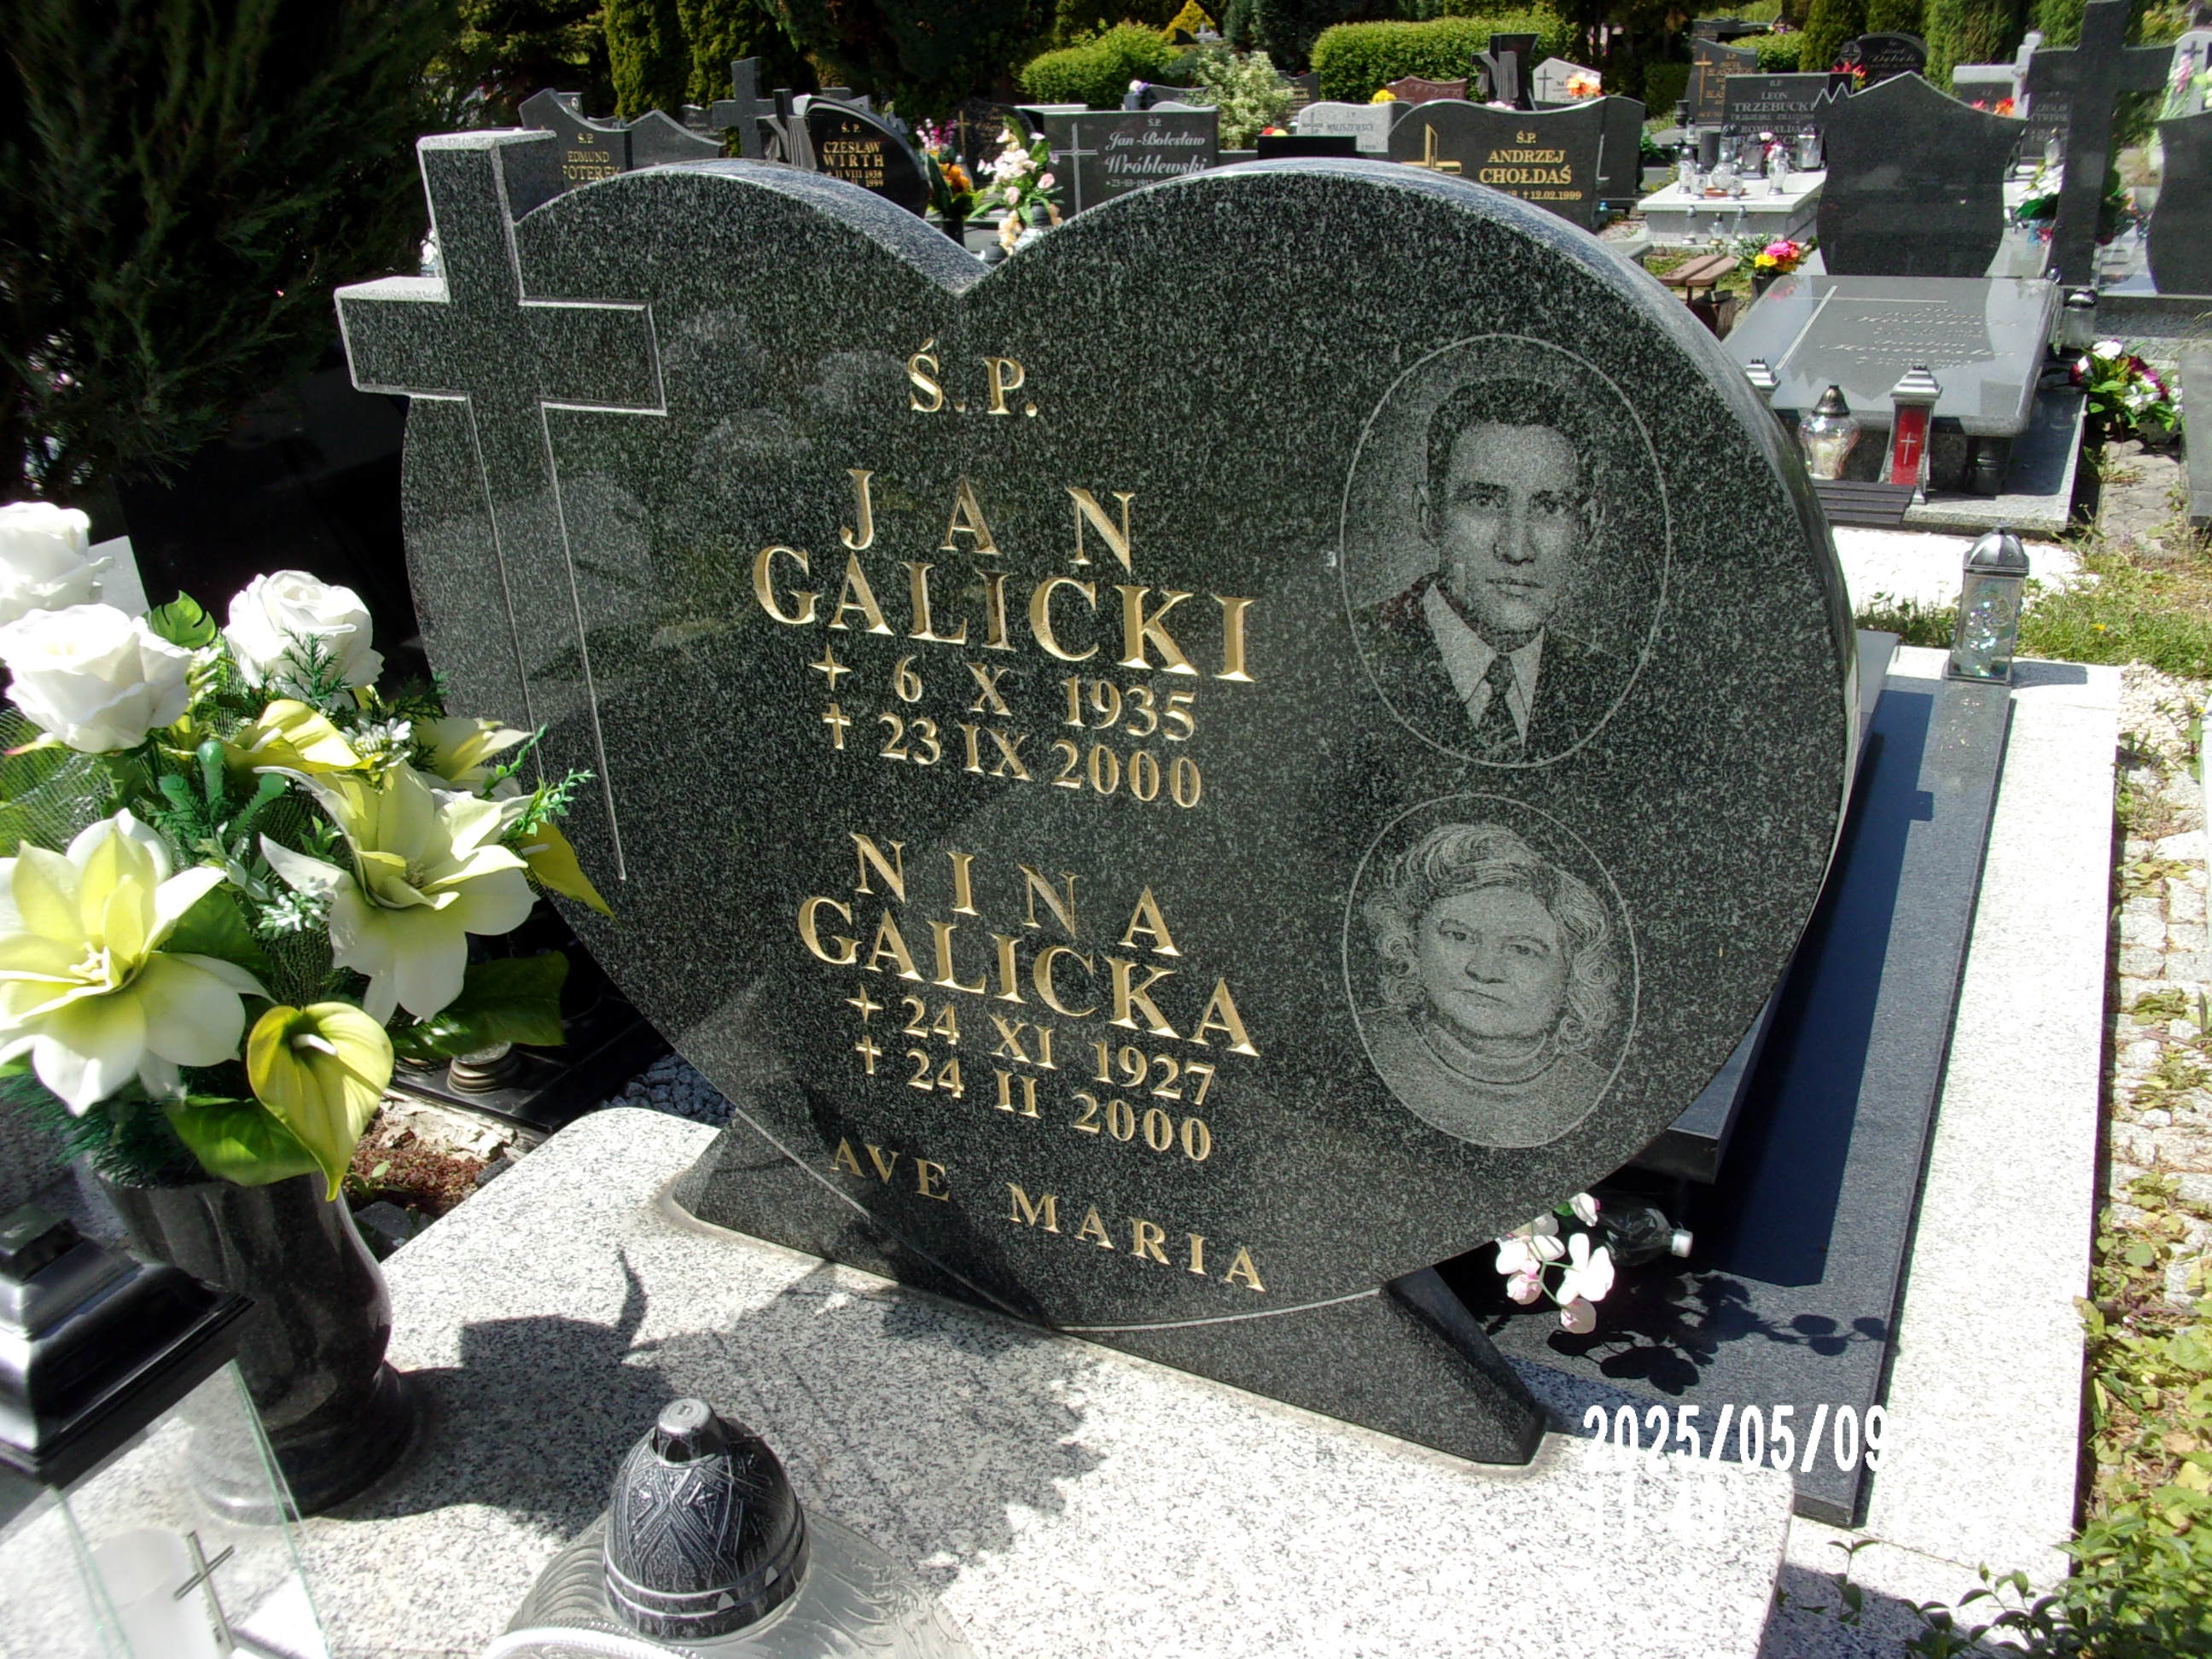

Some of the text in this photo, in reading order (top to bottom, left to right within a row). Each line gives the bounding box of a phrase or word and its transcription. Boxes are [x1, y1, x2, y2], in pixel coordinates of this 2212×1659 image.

[1733, 102, 1815, 112] TRZEBUCKI
[568, 151, 610, 163] EDMUND
[823, 154, 885, 167] WIRTH
[1105, 154, 1208, 174] Wróblewski
[1479, 165, 1572, 184] CHOŁDAŚ
[1487, 149, 1566, 163] ANDRZEJ
[839, 469, 1136, 575] JAN
[752, 545, 1255, 682] GALICKI
[893, 655, 1196, 741] 6 X 1935
[878, 712, 1202, 808] 23 IX 2000
[850, 832, 1182, 957] NINA
[797, 896, 1260, 1057] GALICKA
[901, 995, 1216, 1105] 24 XI 1927
[905, 1048, 1212, 1161] 24 II 2000
[830, 1136, 1266, 1293] AVE MARIA
